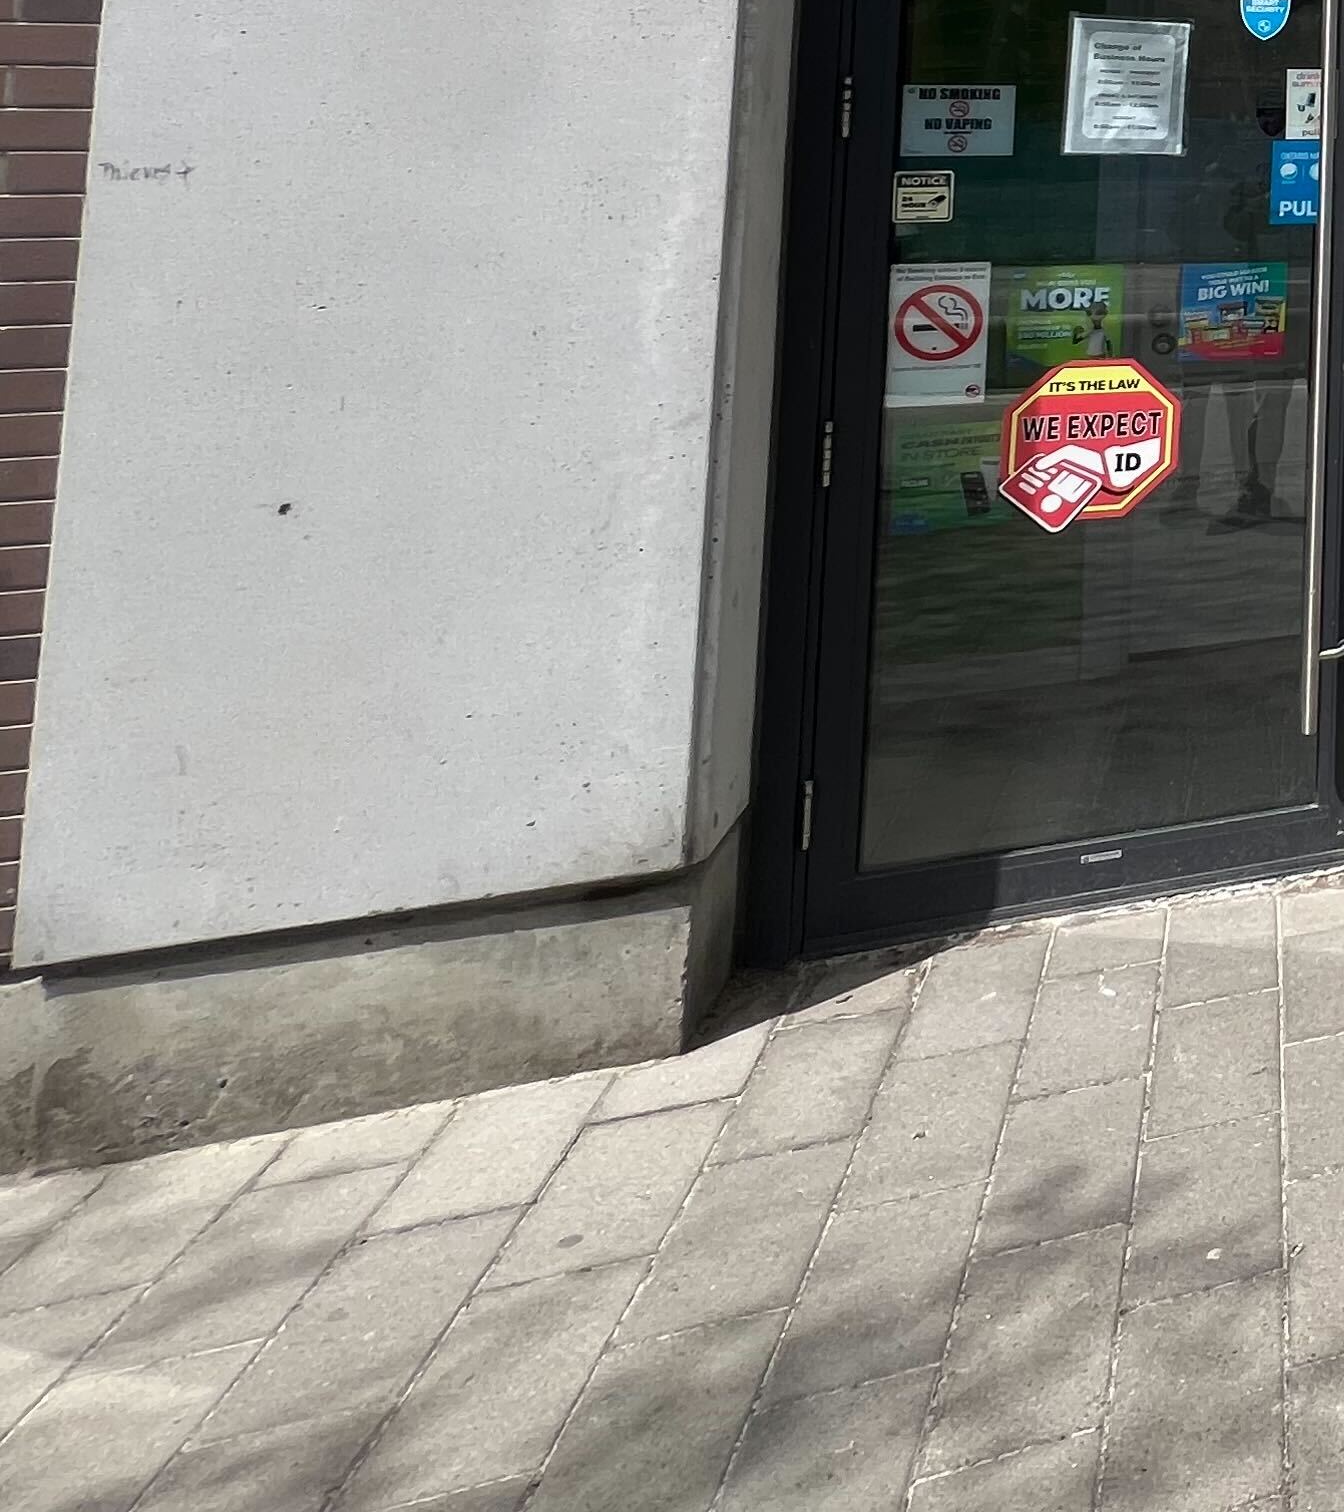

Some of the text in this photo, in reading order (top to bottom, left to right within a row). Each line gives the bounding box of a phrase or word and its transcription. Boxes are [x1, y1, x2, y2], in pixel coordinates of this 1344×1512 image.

[918, 87, 1001, 100] NO SMOKING
[924, 117, 993, 130] NO VAPING
[901, 176, 949, 186] NOTICE
[1279, 200, 1318, 217] PUL
[1020, 287, 1111, 311] MORE
[1197, 280, 1270, 302] BIG WIN!
[1049, 379, 1140, 393] IT'S THE LAW
[1022, 416, 1061, 442] WE
[1066, 411, 1164, 440] EXPECT
[1114, 452, 1142, 473] ID
